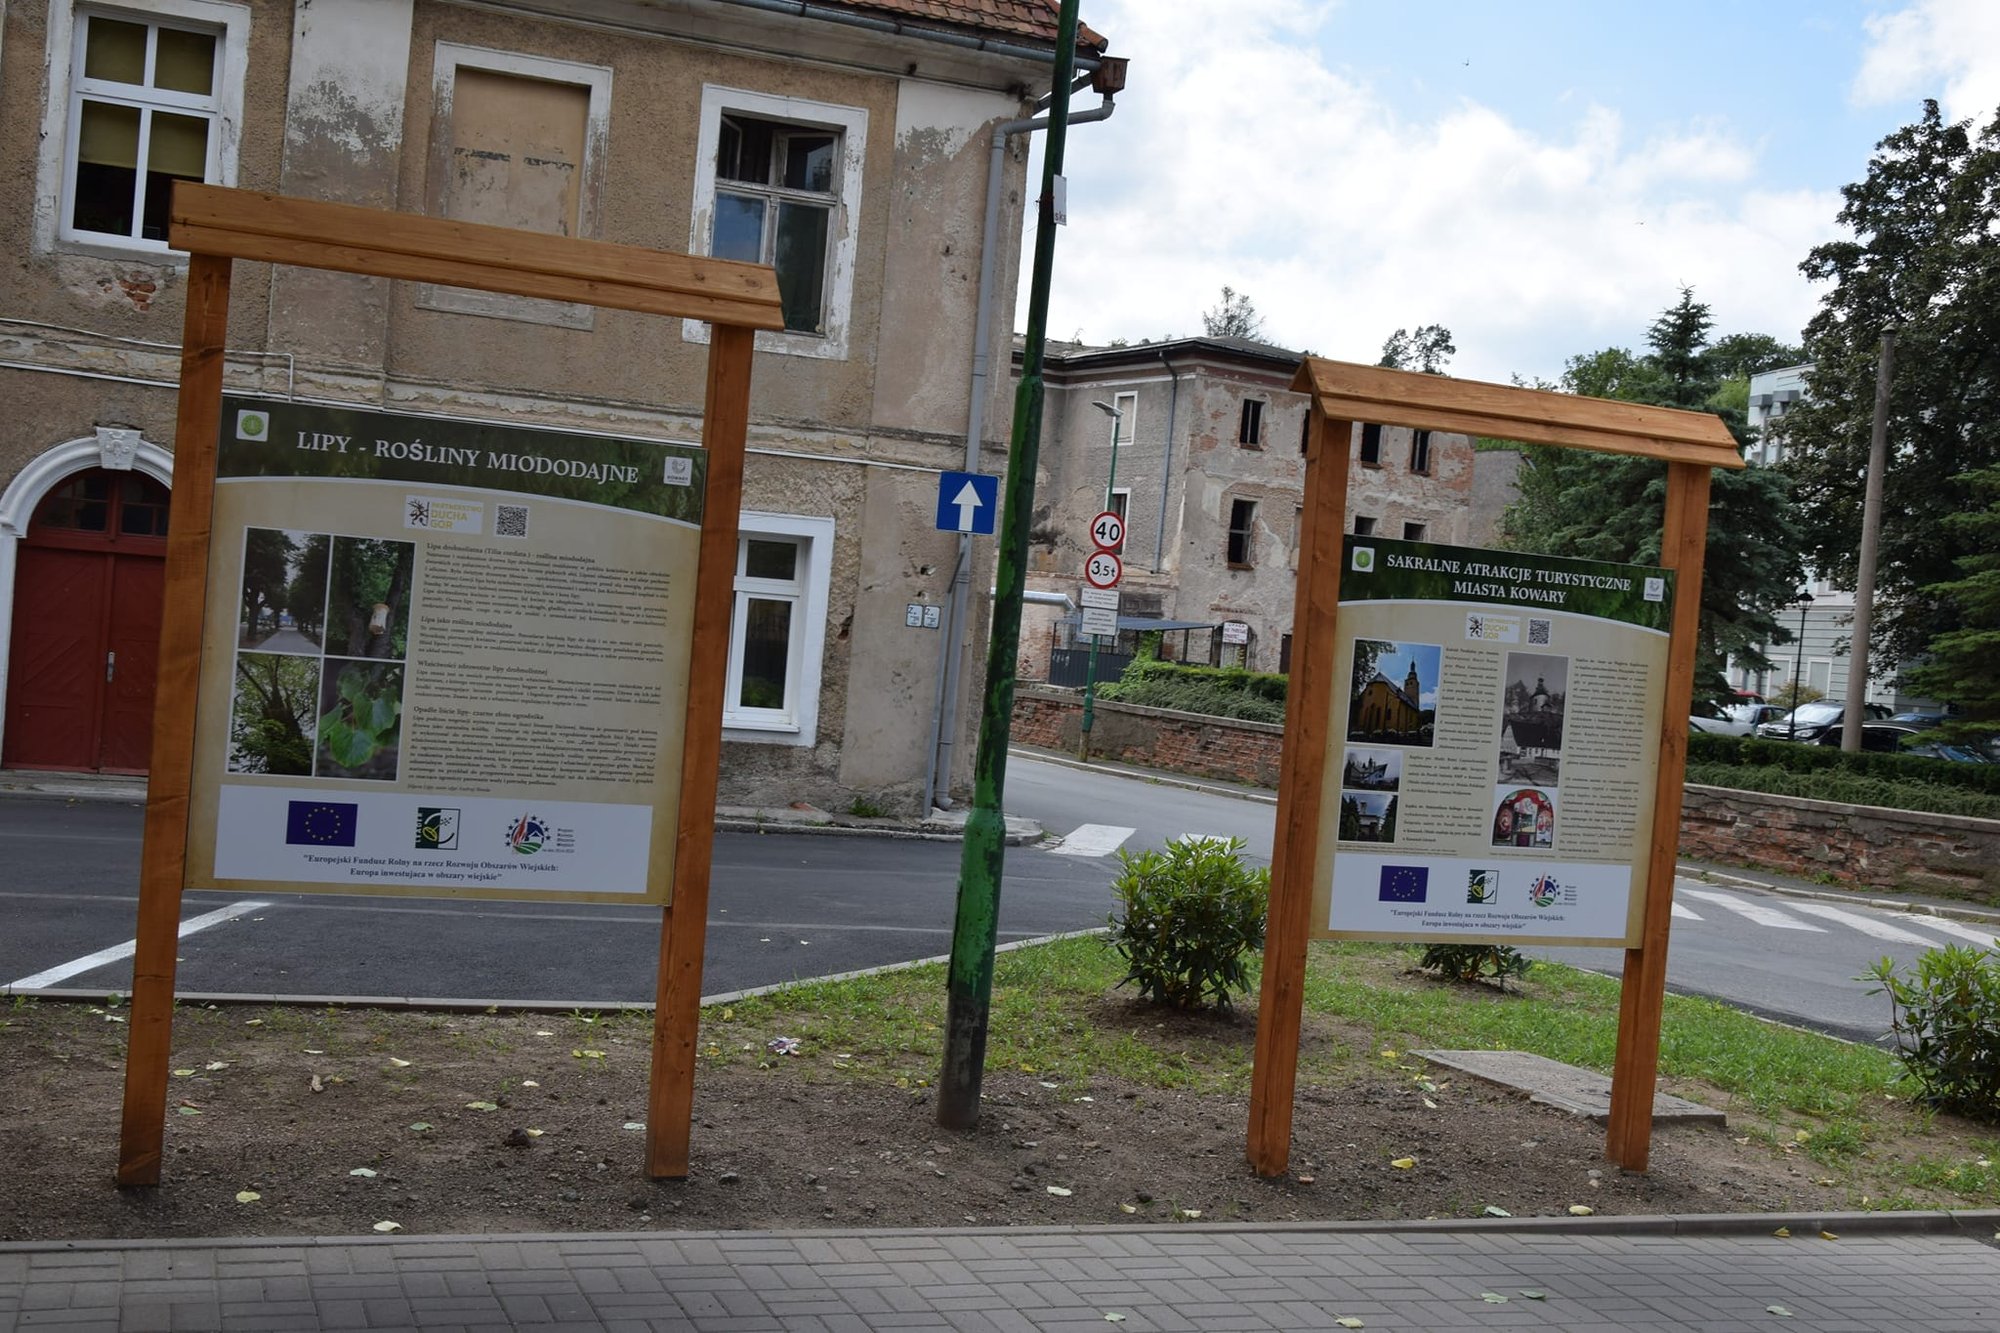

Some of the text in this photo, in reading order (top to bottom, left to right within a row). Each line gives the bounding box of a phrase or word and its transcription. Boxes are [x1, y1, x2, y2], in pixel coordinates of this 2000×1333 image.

[297, 431, 352, 454] LIPY
[374, 438, 481, 467] ROŚLINY
[487, 451, 640, 485] MIODODAJNE
[1095, 521, 1120, 541] 40
[1386, 554, 1632, 592] SAKRALNE ATRAKCJE TURYSTYCZNE
[1453, 580, 1567, 604] MIASTA KOWARY
[350, 867, 379, 878] Europa
[435, 871, 465, 880] obszary
[353, 856, 387, 865] Fundusz
[388, 857, 410, 867] Rolny
[446, 860, 479, 870] Rozwoju
